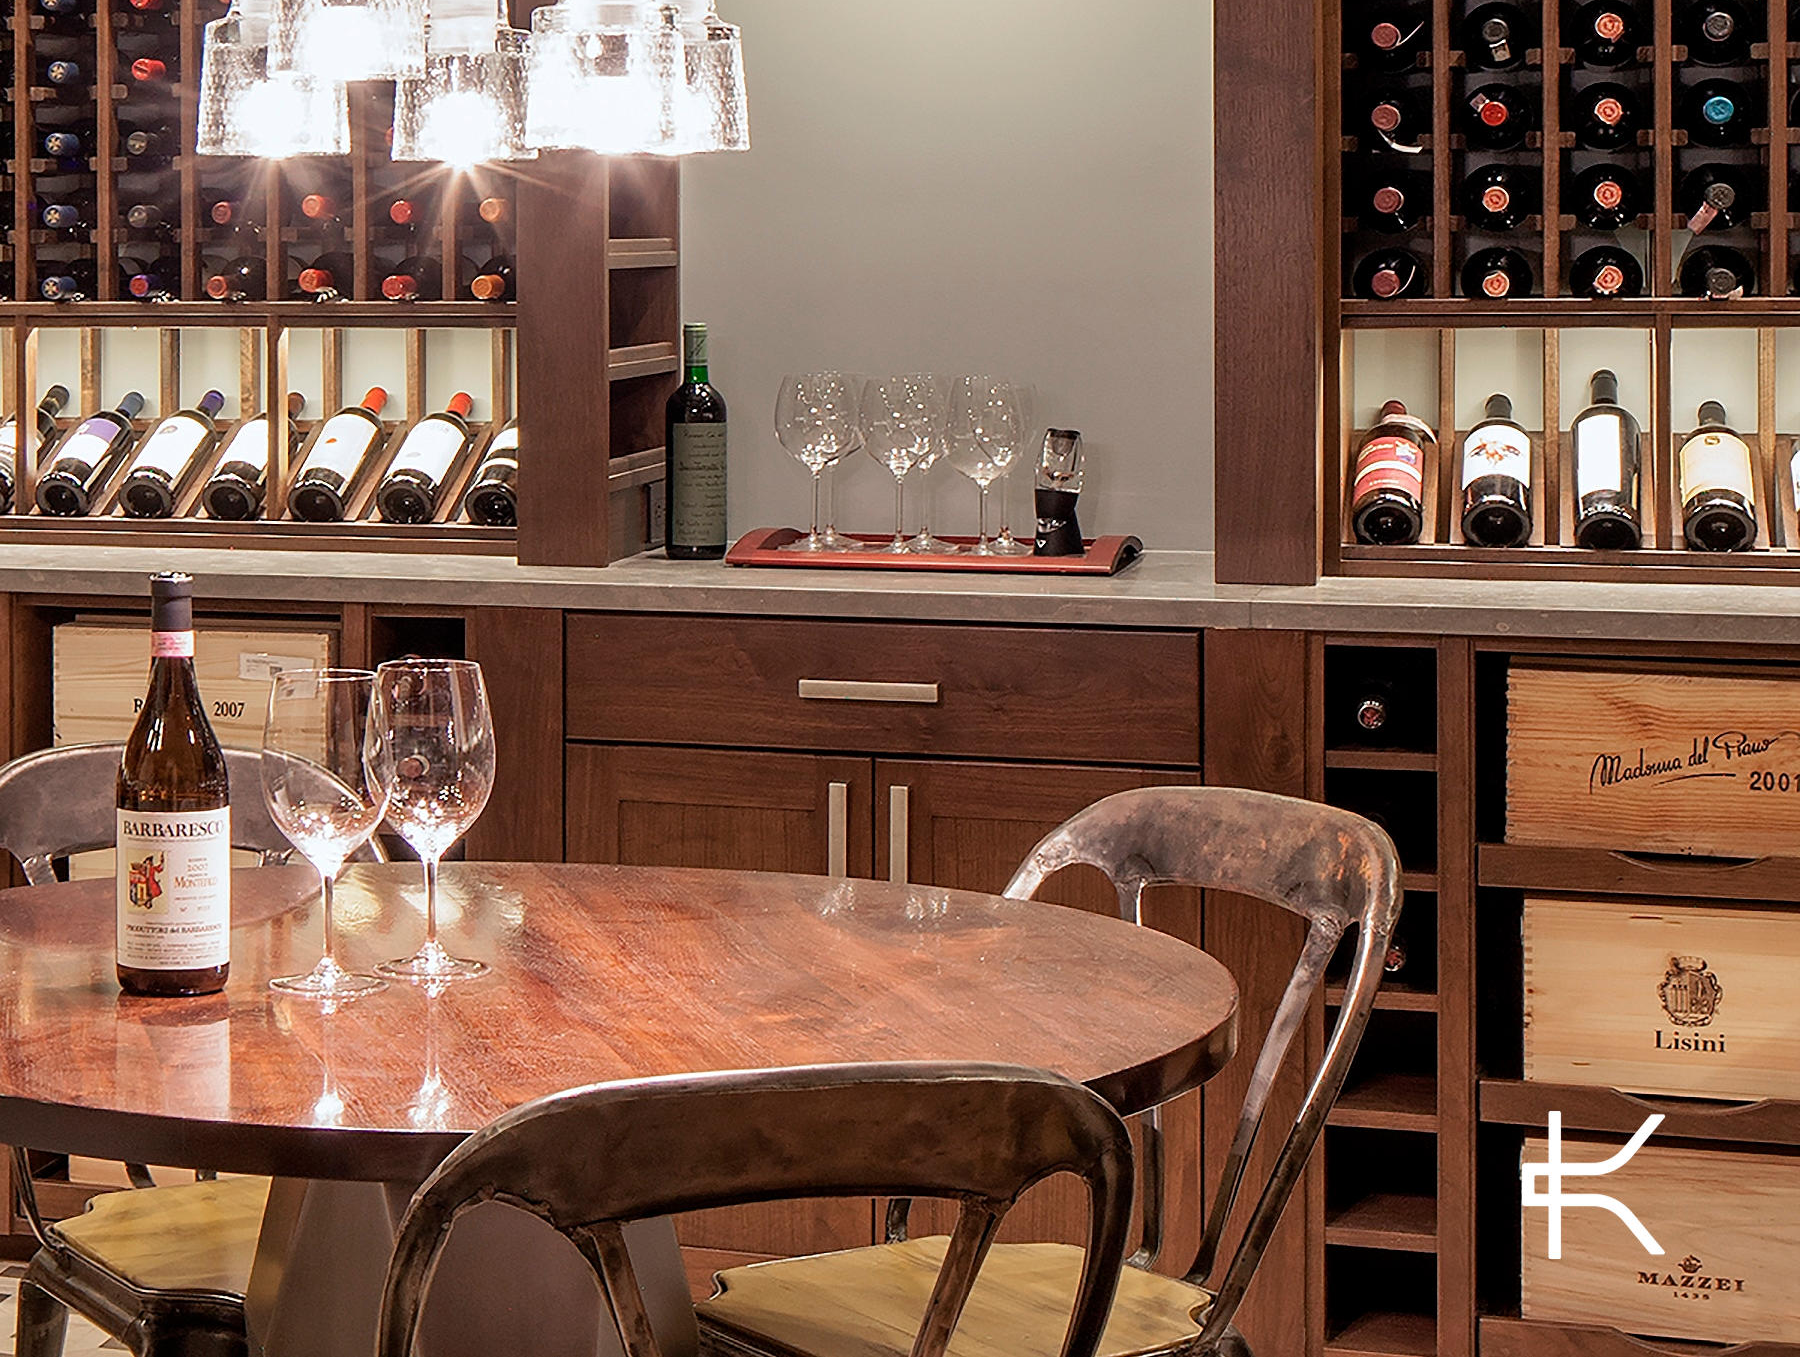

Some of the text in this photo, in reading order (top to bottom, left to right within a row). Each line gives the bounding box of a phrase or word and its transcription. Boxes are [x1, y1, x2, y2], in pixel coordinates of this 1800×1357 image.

[213, 701, 246, 718] 2007
[1589, 748, 1683, 794] Madonna
[1687, 735, 1710, 767] del
[123, 819, 224, 837] BARBARESCO
[1654, 1029, 1727, 1053] Lisini
[1637, 1271, 1746, 1293] MAZZEI
